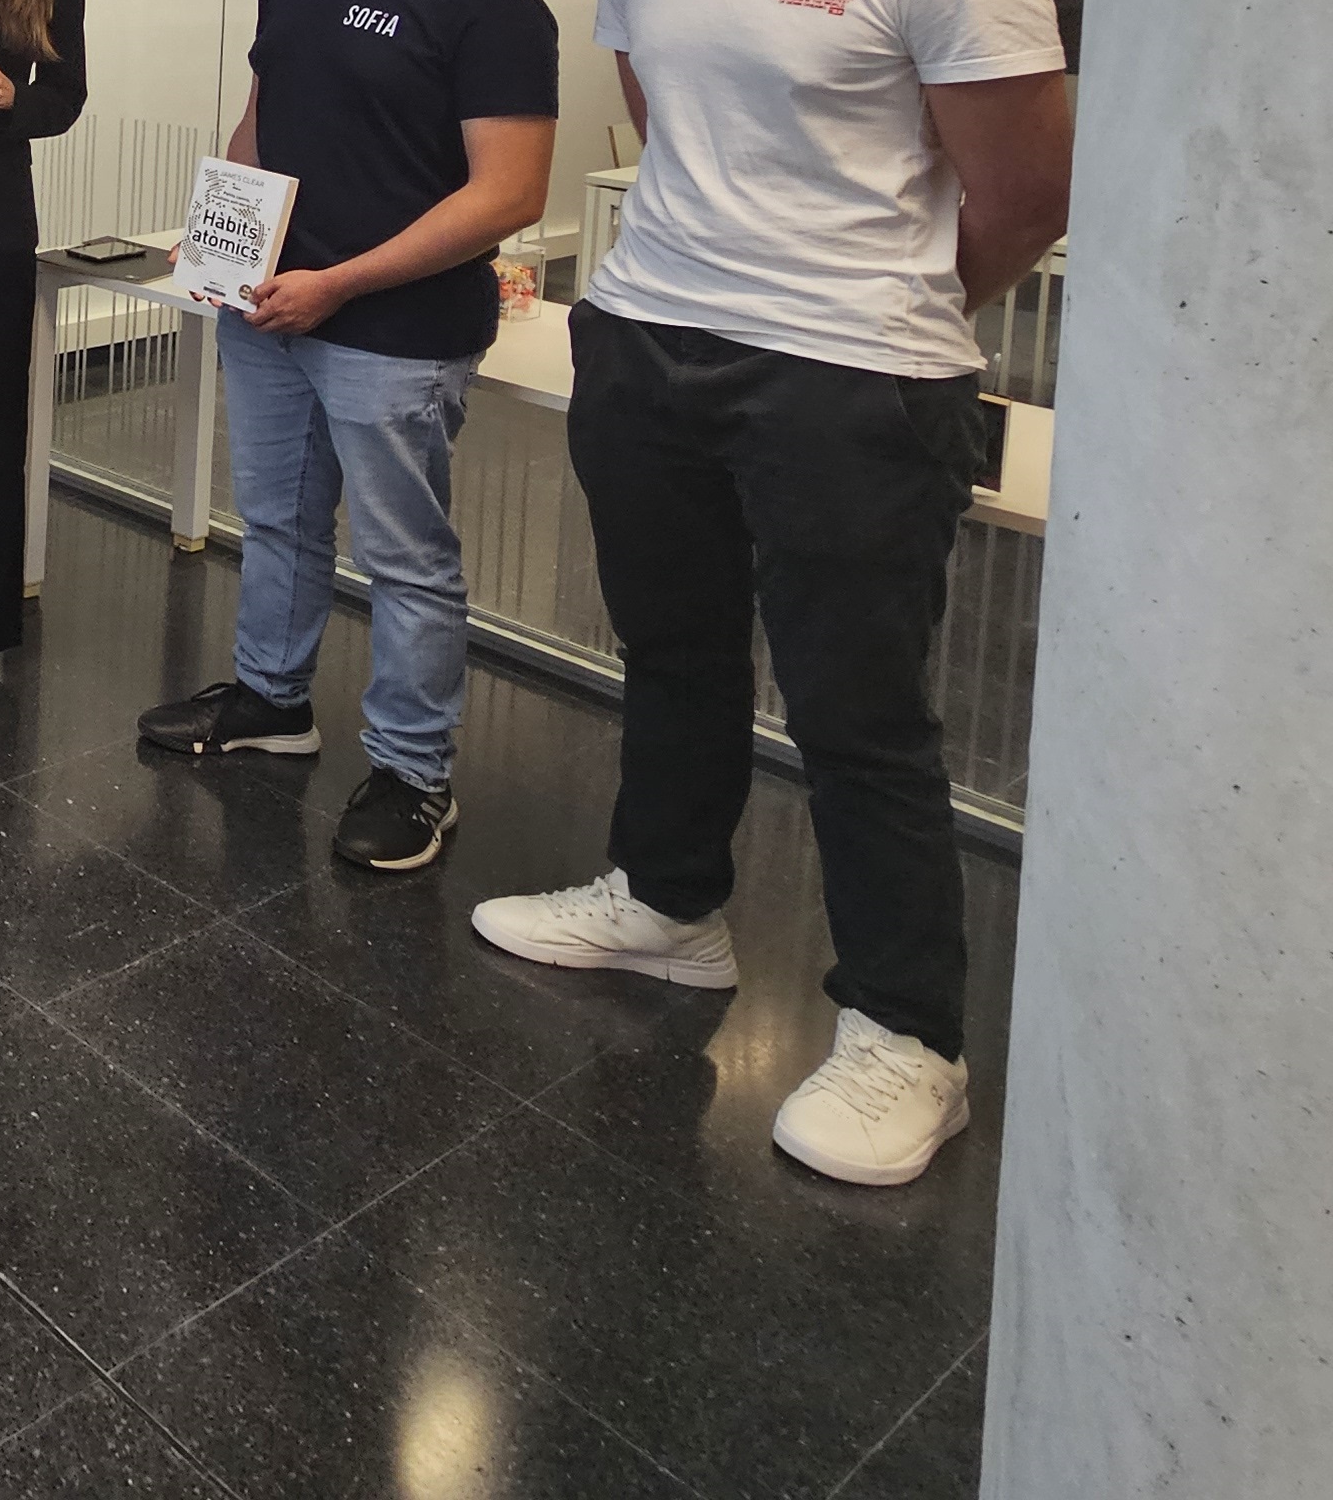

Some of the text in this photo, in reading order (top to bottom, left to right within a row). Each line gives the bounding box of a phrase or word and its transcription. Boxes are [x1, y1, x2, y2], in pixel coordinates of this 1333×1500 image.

[242, 175, 265, 188] CLEAR
[202, 208, 258, 240] Hàbits
[191, 228, 260, 261] atòmics
